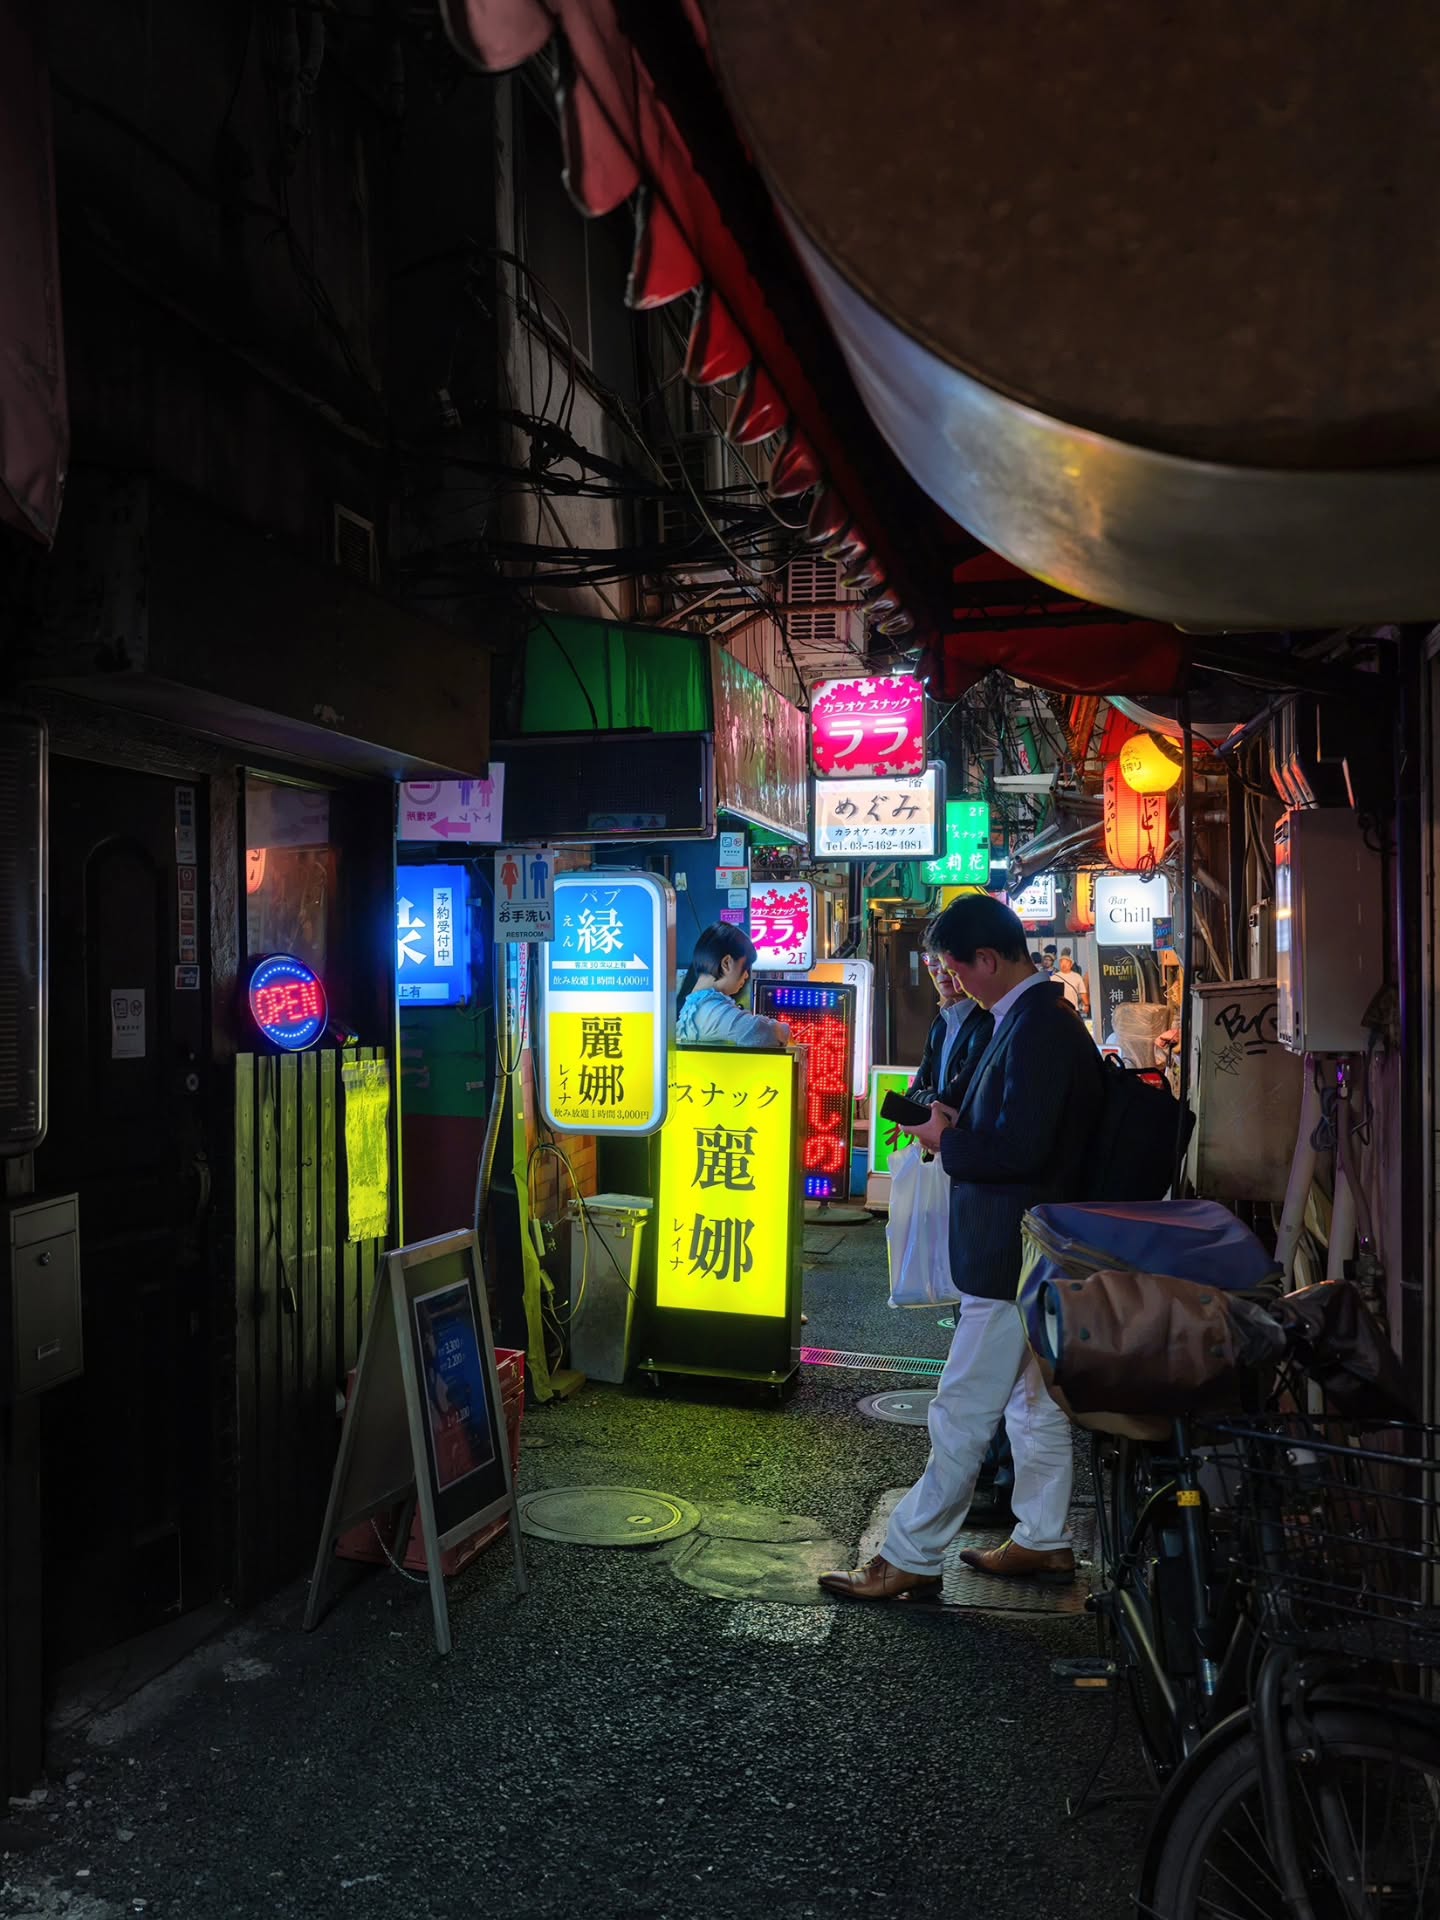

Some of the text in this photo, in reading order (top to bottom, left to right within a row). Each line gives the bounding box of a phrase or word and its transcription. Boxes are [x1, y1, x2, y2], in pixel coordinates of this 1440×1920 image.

[822, 697, 911, 714] カラオケ スナック
[828, 717, 909, 758] ララ
[834, 793, 921, 822] めぐみ
[969, 806, 985, 817] 2F
[579, 888, 622, 907] パブ
[1108, 896, 1128, 905] Bar
[436, 892, 451, 961] 予約受付中
[498, 910, 552, 923] お手洗い
[1109, 907, 1151, 923] Chill
[562, 914, 575, 948] えん
[577, 907, 625, 955] 縁
[751, 919, 795, 944] ララ
[787, 952, 808, 965] 2F
[256, 981, 319, 1025] OPEN
[577, 1016, 625, 1106] 麗娜
[558, 1063, 573, 1106] レイナ
[674, 1081, 780, 1109] スナック
[687, 1123, 759, 1283] 麗娜
[669, 1217, 685, 1272] レイナ
